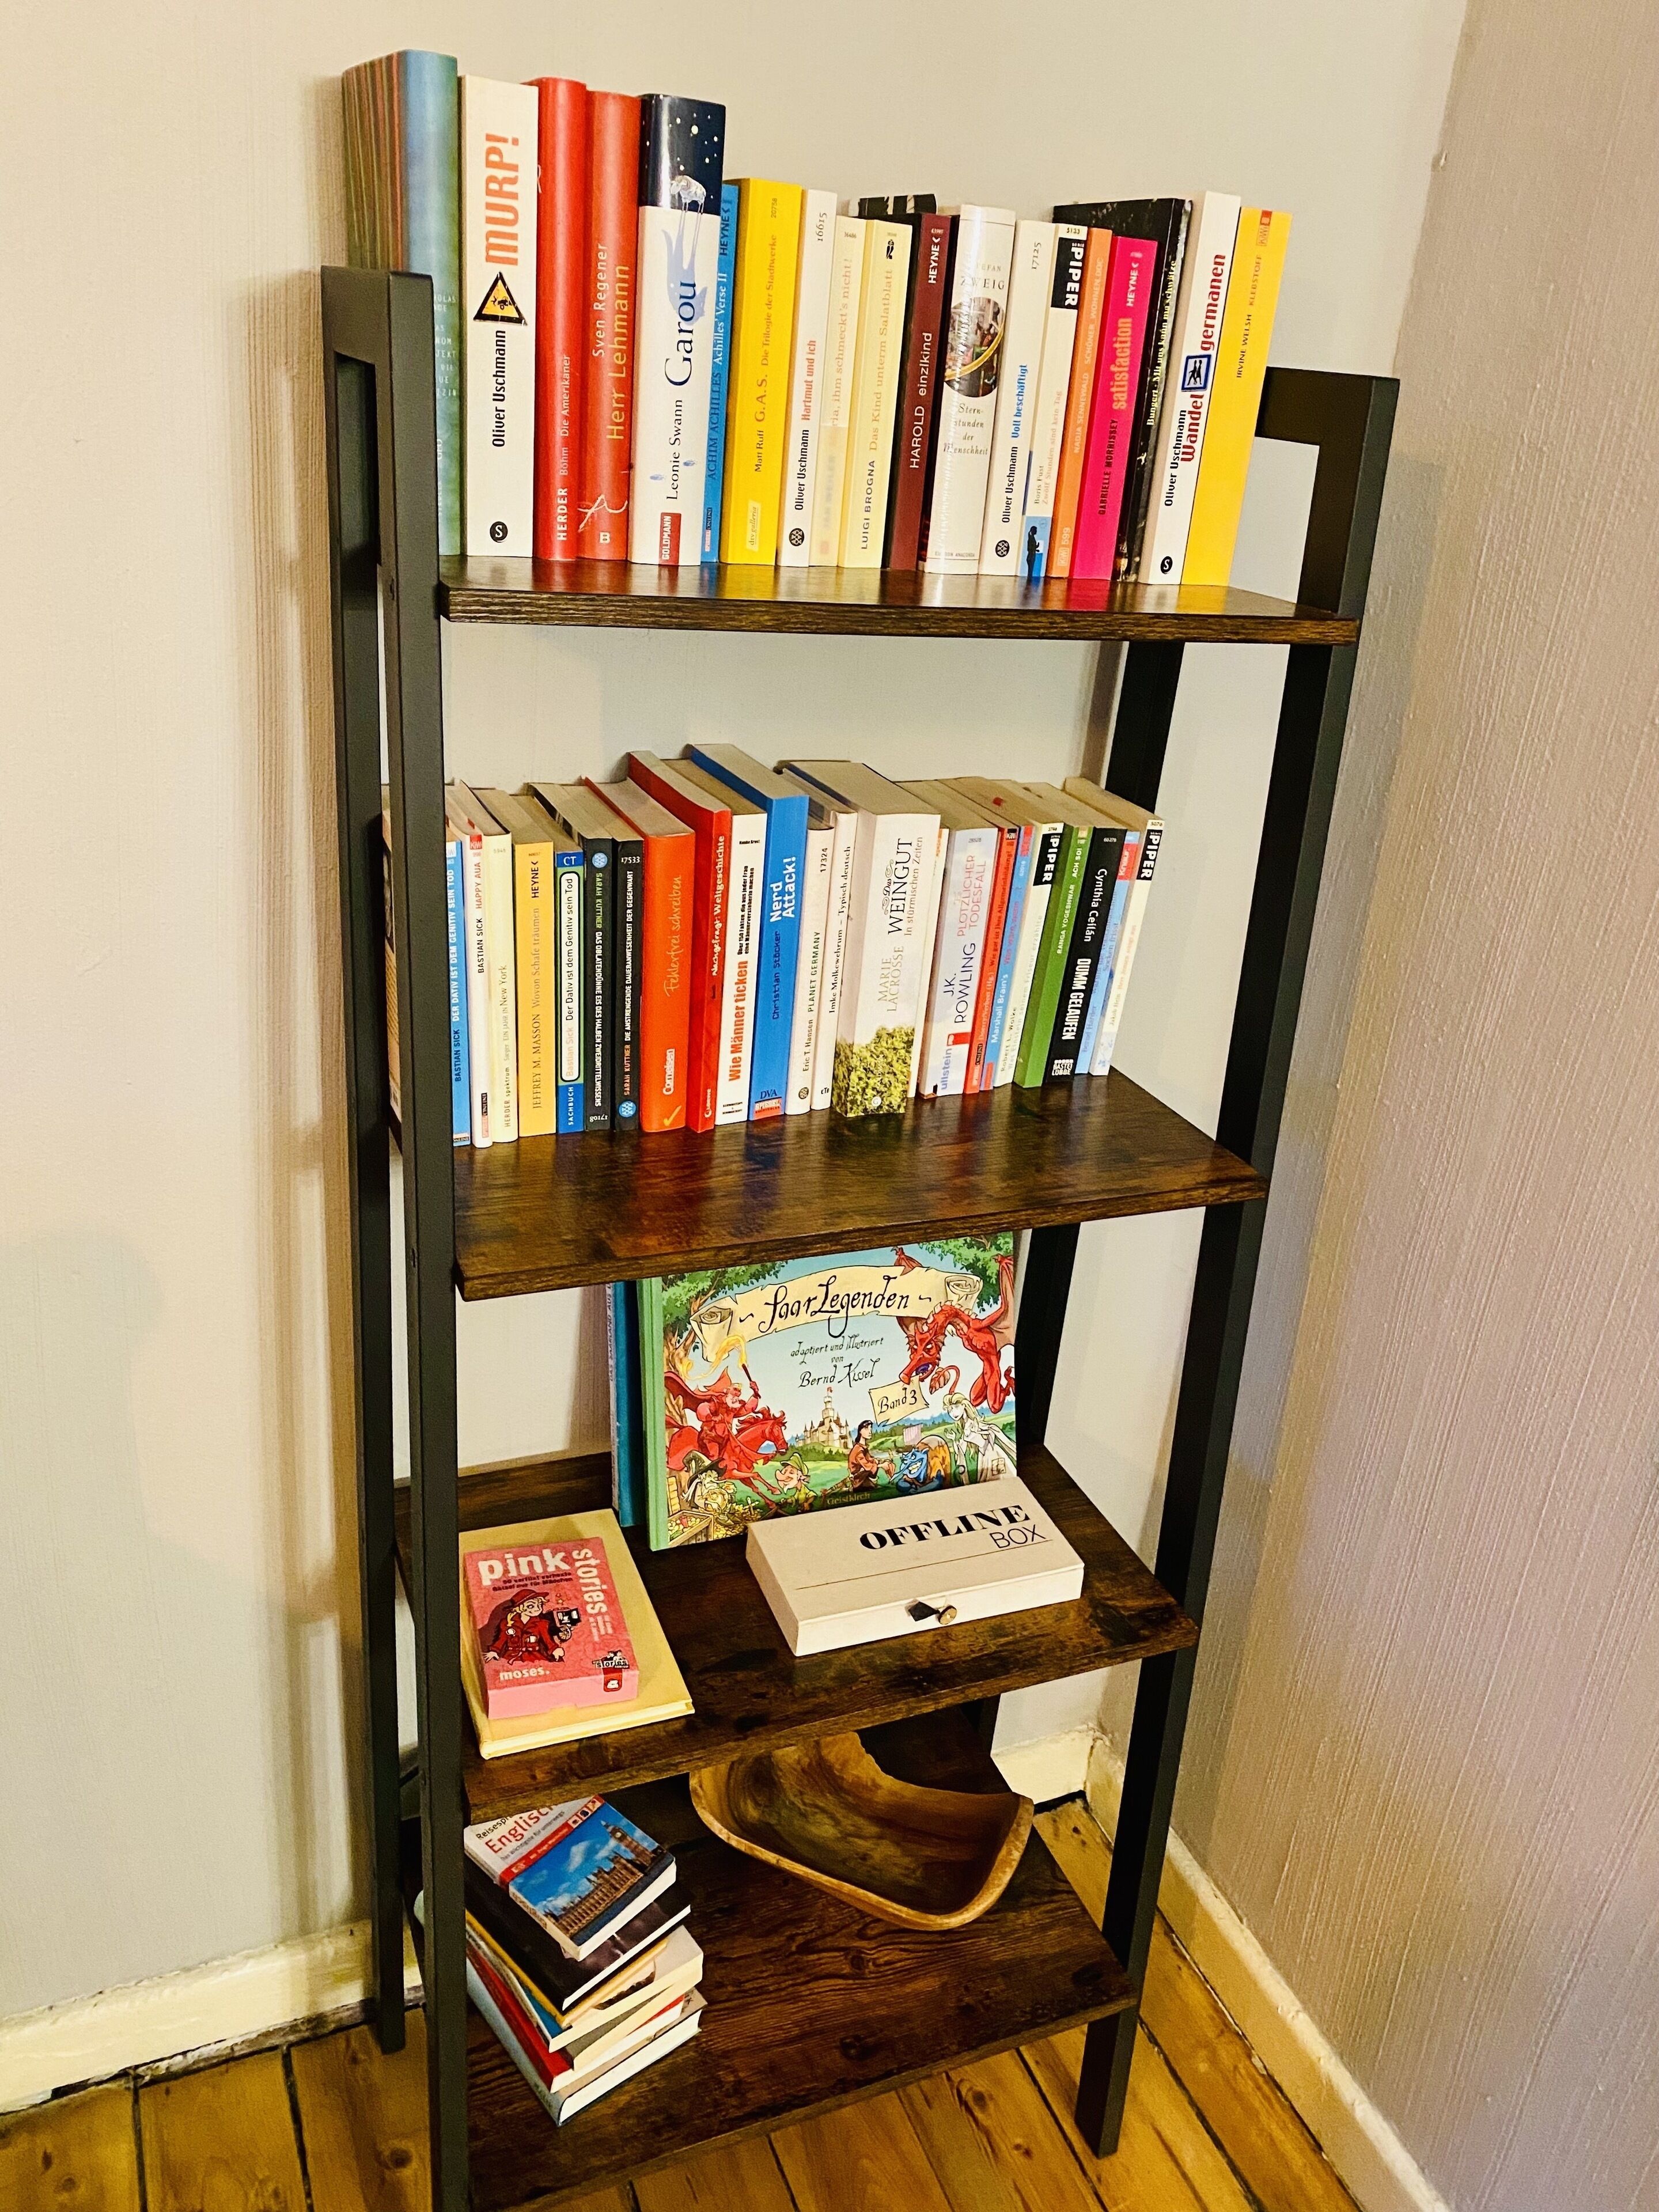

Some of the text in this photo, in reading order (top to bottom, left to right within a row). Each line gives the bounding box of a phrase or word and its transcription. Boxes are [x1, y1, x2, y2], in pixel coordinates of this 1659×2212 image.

[485, 132, 519, 266] MURP!
[766, 235, 777, 290] Stadtwerke
[1065, 248, 1084, 306] PIPER
[592, 243, 608, 358] Sven Regener
[761, 312, 772, 347] Trilogie
[1236, 314, 1252, 378] IRVINE WELSH
[607, 263, 629, 440] Herr Lehmann
[761, 350, 769, 366] Die
[794, 212, 827, 510] Oliver Uschmann Hartmut und ich 16615
[910, 406, 924, 468] HAROLD
[918, 332, 932, 396] einzlkind
[928, 244, 940, 283] HEYNE
[1181, 254, 1225, 461] Wandel germanen
[492, 331, 506, 448] Oliver Uschmann
[664, 281, 696, 499] Leonie Swann Garou
[707, 286, 726, 480] ACHIM ACHILLES Verse
[830, 377, 842, 402] ihm
[1002, 242, 1041, 522] Oliver Uschmann Voll beschäftigt 17125
[1098, 270, 1139, 514] GABRIELLE MORRISSEY satisfaction HEYNE
[861, 270, 893, 550] LUIGI BROGNA Das Kind unterm Salatblatt
[557, 355, 571, 541] HERDER Die Amerikaner
[756, 430, 764, 449] Ruff
[1164, 410, 1186, 506] Oliver Uschmann
[662, 516, 671, 560] GOLDMANN
[1061, 527, 1071, 545] 599
[563, 857, 577, 866] CT
[714, 836, 725, 916] Weltgeschichte
[840, 846, 851, 880] deutsch
[1042, 839, 1060, 882] PIPER
[1141, 834, 1161, 878] PIPER
[447, 870, 455, 887] TOD
[531, 867, 539, 899] HEYNE
[565, 879, 573, 894] Tod
[782, 857, 796, 918] Attack!
[888, 838, 912, 935] WEINGUT
[906, 837, 922, 923] stürmischen Zeiten
[968, 861, 986, 929] TODESFALL
[1091, 869, 1107, 907] Cynthia
[770, 881, 783, 922] Nerd
[838, 883, 848, 916] Typisch
[1056, 862, 1080, 954] RANGA YOGESHWAR ACH
[449, 912, 457, 943] GENITIV
[565, 917, 573, 946] Genitiv
[449, 946, 457, 964] DEM
[450, 966, 458, 979] IST
[531, 948, 540, 975] Schafe
[565, 949, 573, 967] dem
[625, 923, 633, 984] DAUERANWESENHEIT
[810, 931, 820, 976] GERMANY
[450, 982, 459, 1003] DATIV
[498, 965, 507, 986] York
[531, 978, 540, 1008] Wovon
[565, 971, 573, 980] ist
[662, 876, 684, 1094] Cornelsen Fehlerfrei schreiben
[877, 958, 891, 1001] MARIE
[887, 946, 904, 1012] LACROSSE
[943, 974, 956, 997] J.K.
[954, 943, 976, 1023] ROWLING
[451, 1006, 460, 1022] DER
[499, 988, 507, 1006] New
[771, 973, 780, 1020] Christian
[808, 980, 817, 1012] PLANET
[828, 993, 837, 1013] Imke
[1061, 959, 1091, 1040] DUMM GELAUFEN
[532, 1014, 541, 1054] MASSON
[728, 961, 748, 1081] Wie Männer ticken
[805, 1020, 813, 1047] Hansen
[991, 1006, 1003, 1043] Marshall
[1008, 1007, 1017, 1032] Wolke
[453, 1050, 461, 1082] BASTIAN
[802, 1057, 810, 1071] Eric
[940, 1048, 952, 1090] ullstein
[532, 1073, 543, 1109] JEFFREY
[760, 1089, 778, 1099] DVA
[798, 1357, 881, 1388] Bernd Kissel
[877, 1387, 918, 1415] Band 3
[859, 1504, 1031, 1550] OFFLINE
[988, 1524, 1046, 1549] BOX
[477, 1548, 571, 1586] pink
[571, 1548, 608, 1614] stories
[499, 1666, 550, 1681] moses.
